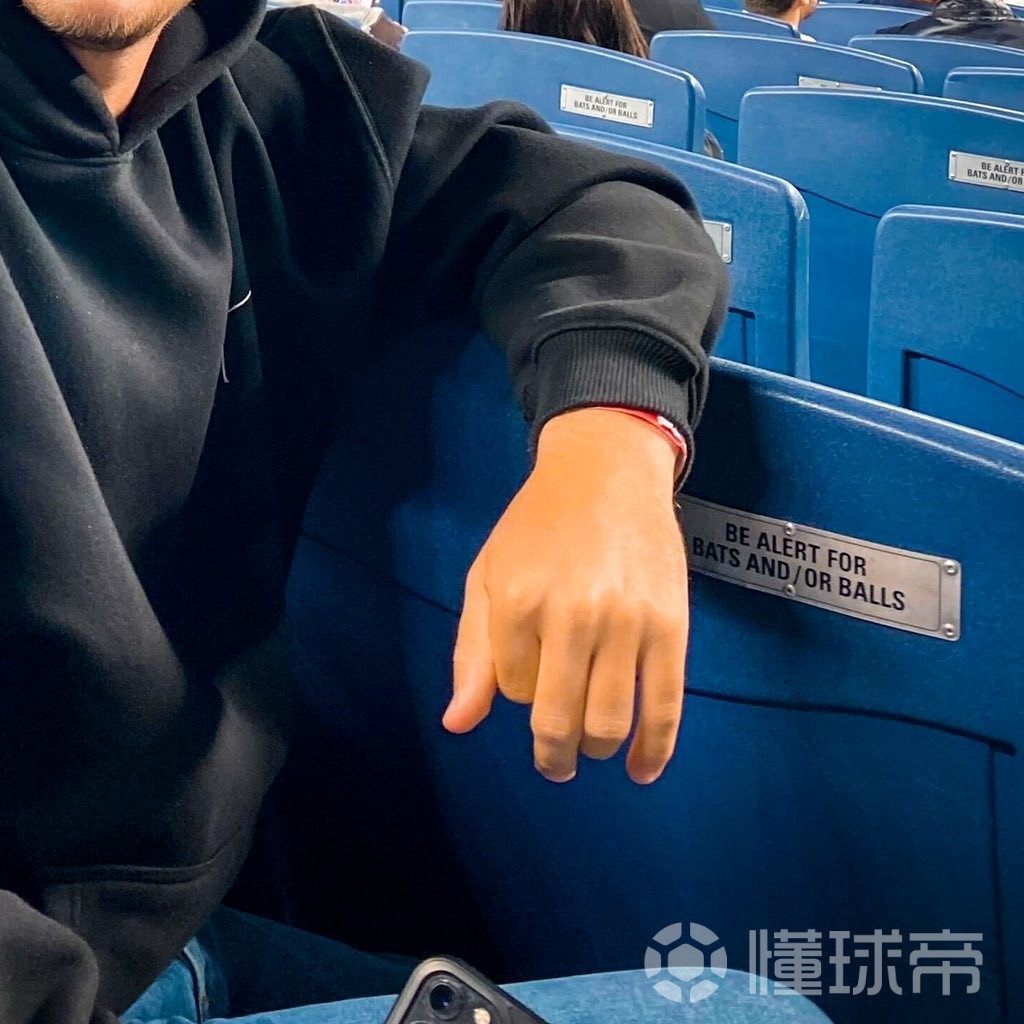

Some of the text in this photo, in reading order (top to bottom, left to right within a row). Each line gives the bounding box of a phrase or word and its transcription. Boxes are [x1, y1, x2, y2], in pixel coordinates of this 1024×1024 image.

[574, 101, 638, 120] BATS AND/OR BALLS
[585, 94, 628, 109] BE ALERT FOR
[967, 168, 988, 180] BATS
[989, 172, 1023, 186] AND/OR
[981, 161, 992, 171] BE
[993, 163, 1020, 175] ALERT
[725, 522, 867, 577] BE ALERT FOR
[692, 536, 906, 612] BATS AND/OR BALLS
